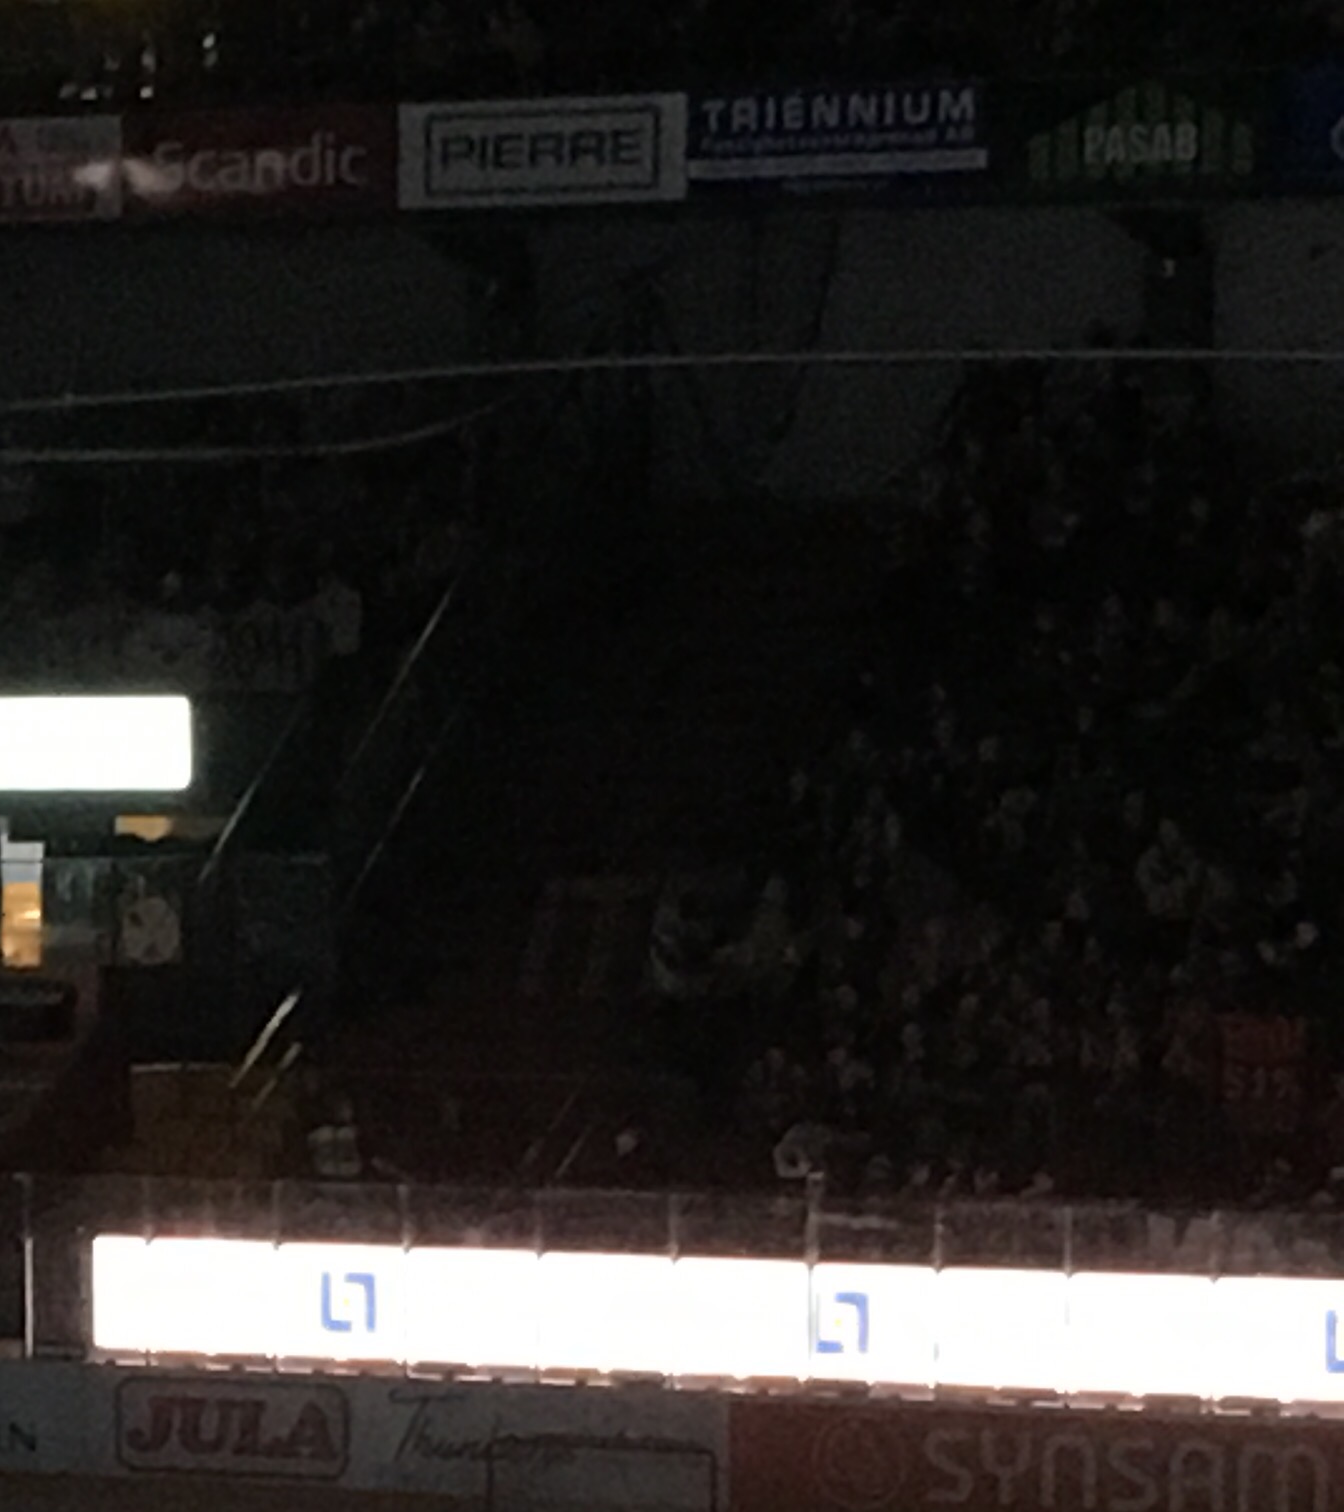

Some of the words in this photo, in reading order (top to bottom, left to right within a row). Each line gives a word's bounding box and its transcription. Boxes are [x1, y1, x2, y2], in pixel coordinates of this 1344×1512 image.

[701, 87, 976, 134] TRIENNIUM
[153, 131, 368, 196] Scandic
[439, 127, 645, 173] PIERRE
[126, 1398, 340, 1462] JULA
